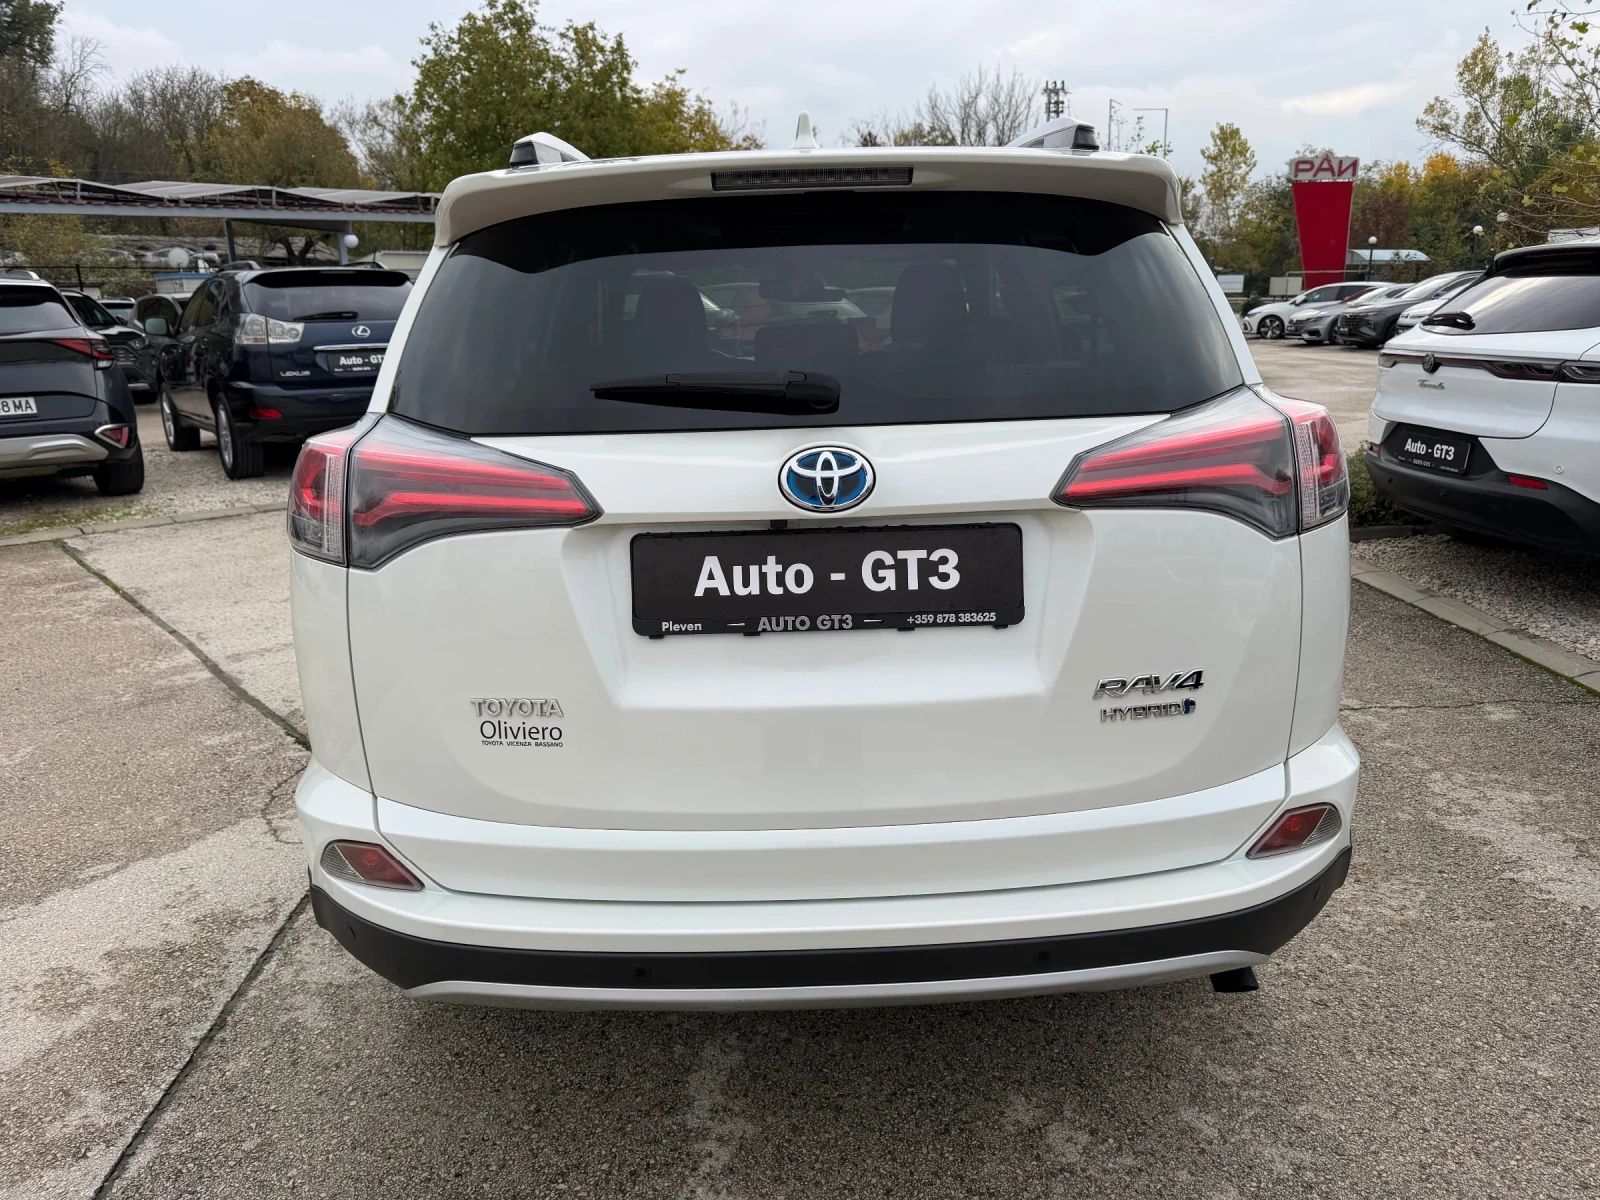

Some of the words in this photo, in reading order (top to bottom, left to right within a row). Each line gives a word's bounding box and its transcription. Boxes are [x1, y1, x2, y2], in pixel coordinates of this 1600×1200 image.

[340, 356, 363, 365] Auto
[370, 354, 386, 364] GT
[0, 400, 11, 413] 8
[12, 399, 34, 412] MA
[1404, 438, 1427, 455] Auto
[1433, 443, 1455, 461] GT3
[694, 554, 814, 597] Auto
[830, 572, 846, 581] -
[861, 548, 961, 592] GT3
[661, 621, 702, 632] Pleven
[757, 615, 811, 632] AUTO
[816, 614, 853, 630] GT3
[907, 614, 934, 624] +359
[936, 613, 956, 623] 878
[958, 612, 997, 622] 383625
[1092, 668, 1205, 700] RAV4
[470, 698, 564, 718] TOYOTA
[1100, 702, 1181, 723] HYBRID
[480, 720, 563, 741] Oliviero
